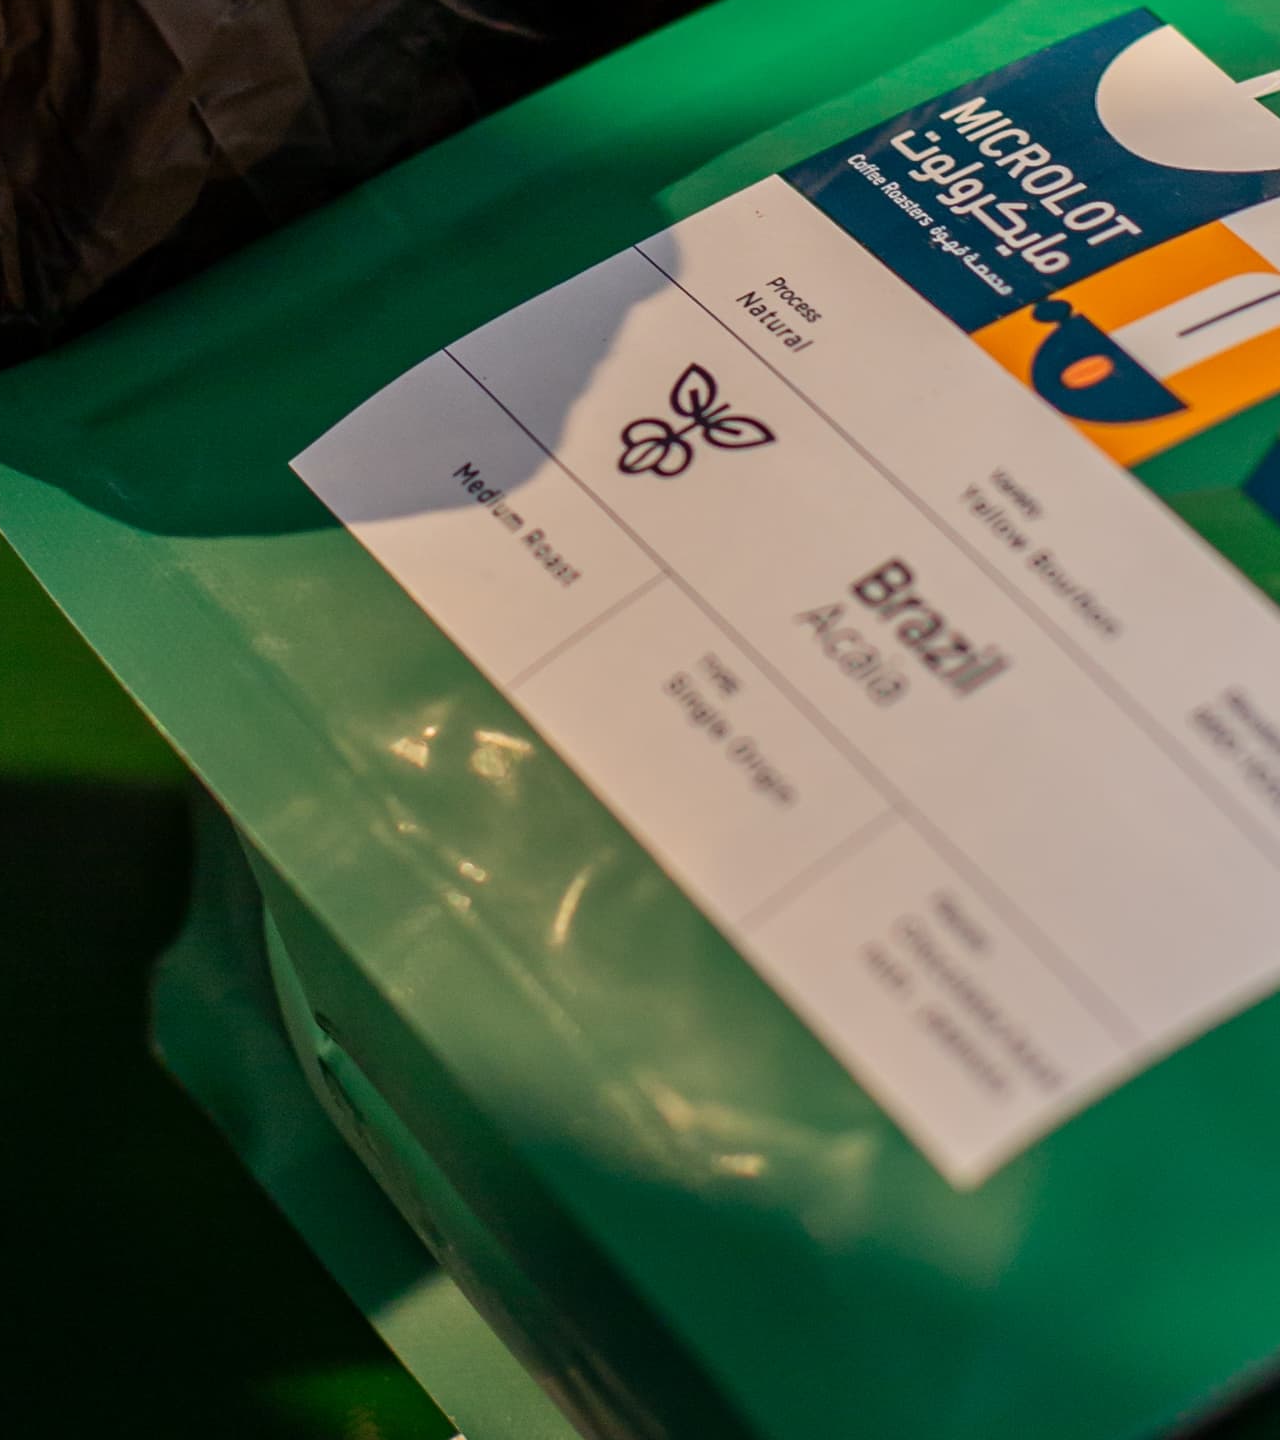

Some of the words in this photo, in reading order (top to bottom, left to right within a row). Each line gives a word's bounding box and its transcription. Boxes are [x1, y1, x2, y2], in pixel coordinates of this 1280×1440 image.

[847, 153, 886, 186] Coffee
[880, 181, 934, 227] Roasters
[890, 129, 1071, 274] مايكرولوت
[939, 96, 1143, 246] MICROLOT
[736, 291, 814, 353] Natural
[766, 277, 822, 323] Process
[453, 461, 524, 533] Medium
[521, 528, 582, 588] Roast
[851, 557, 1010, 698] Brazil
